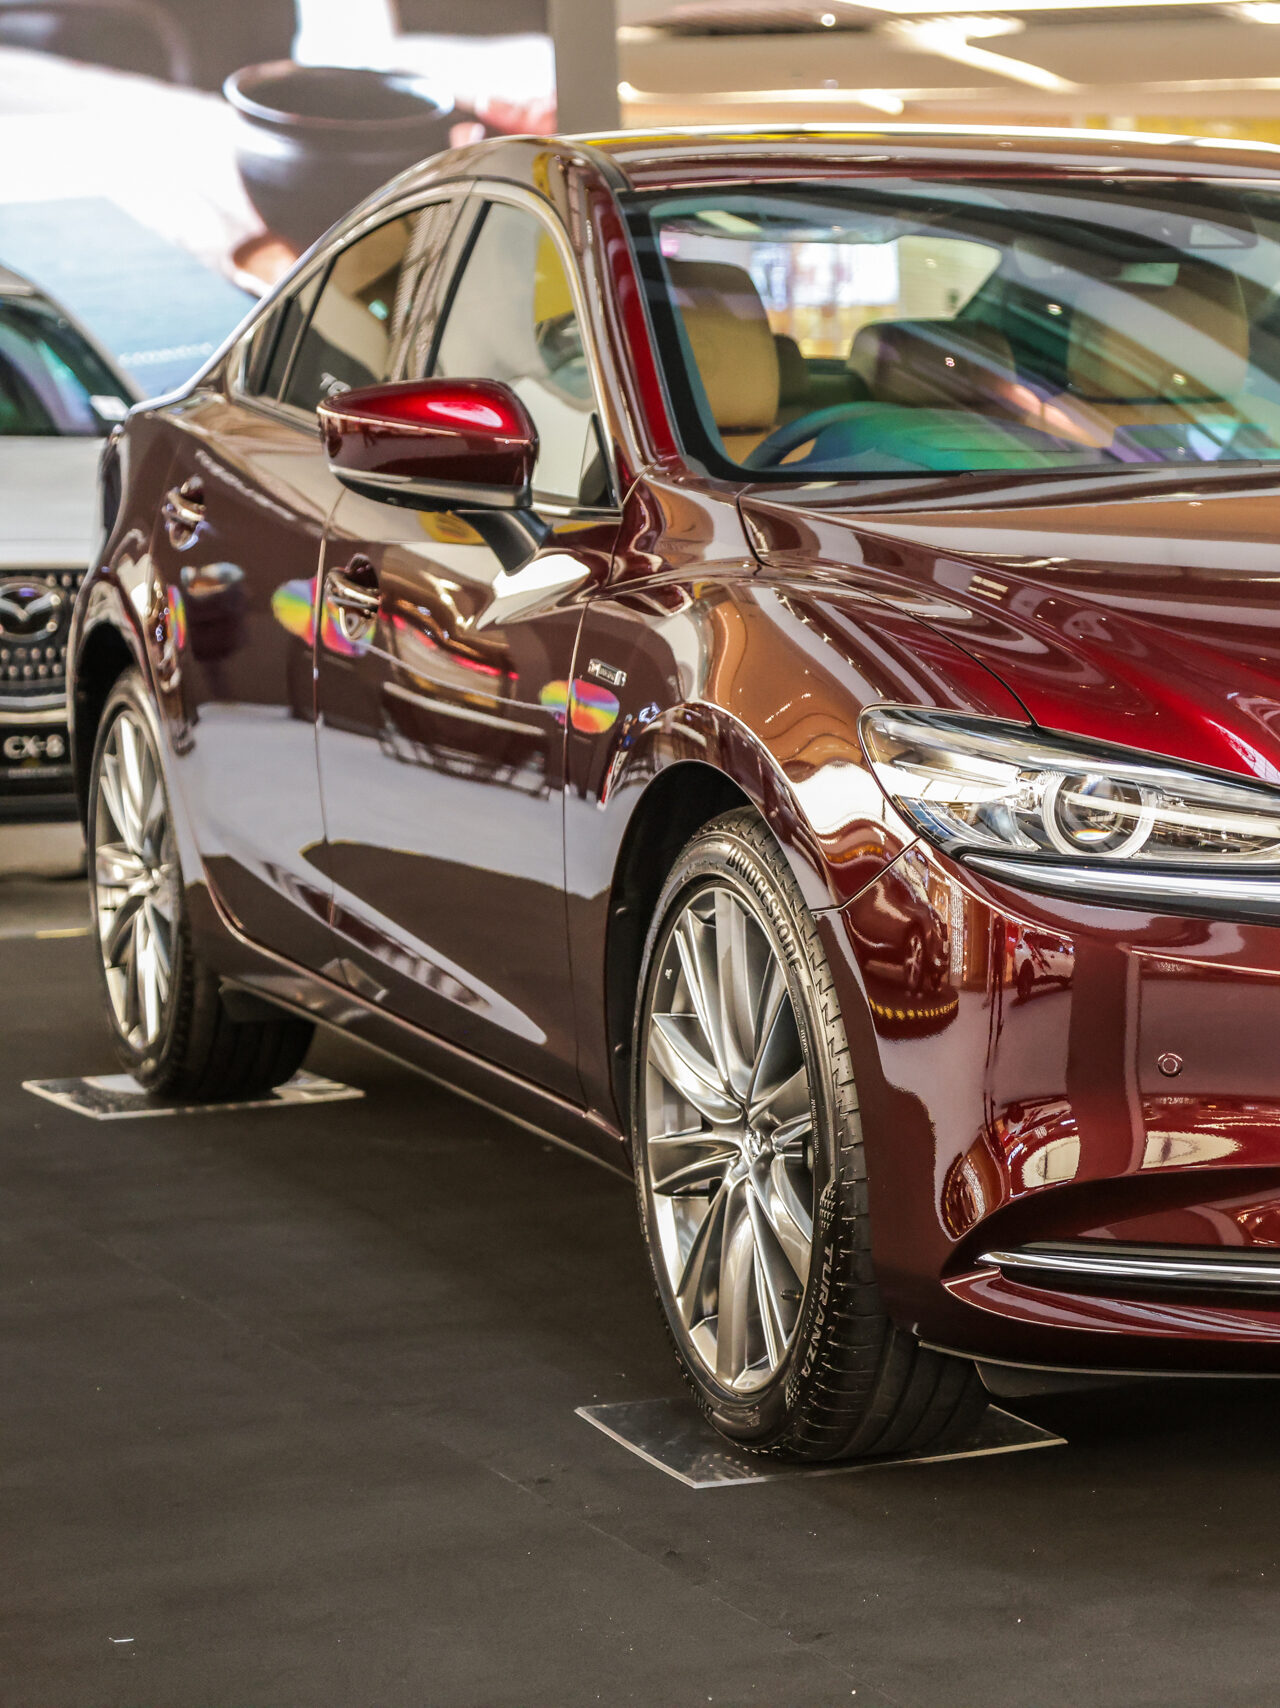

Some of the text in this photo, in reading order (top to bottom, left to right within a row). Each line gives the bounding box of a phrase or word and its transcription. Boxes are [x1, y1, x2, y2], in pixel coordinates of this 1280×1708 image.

[3, 734, 65, 759] CX-8
[726, 843, 803, 977] BRIDGESTONE
[801, 1243, 834, 1379] TURANZA
